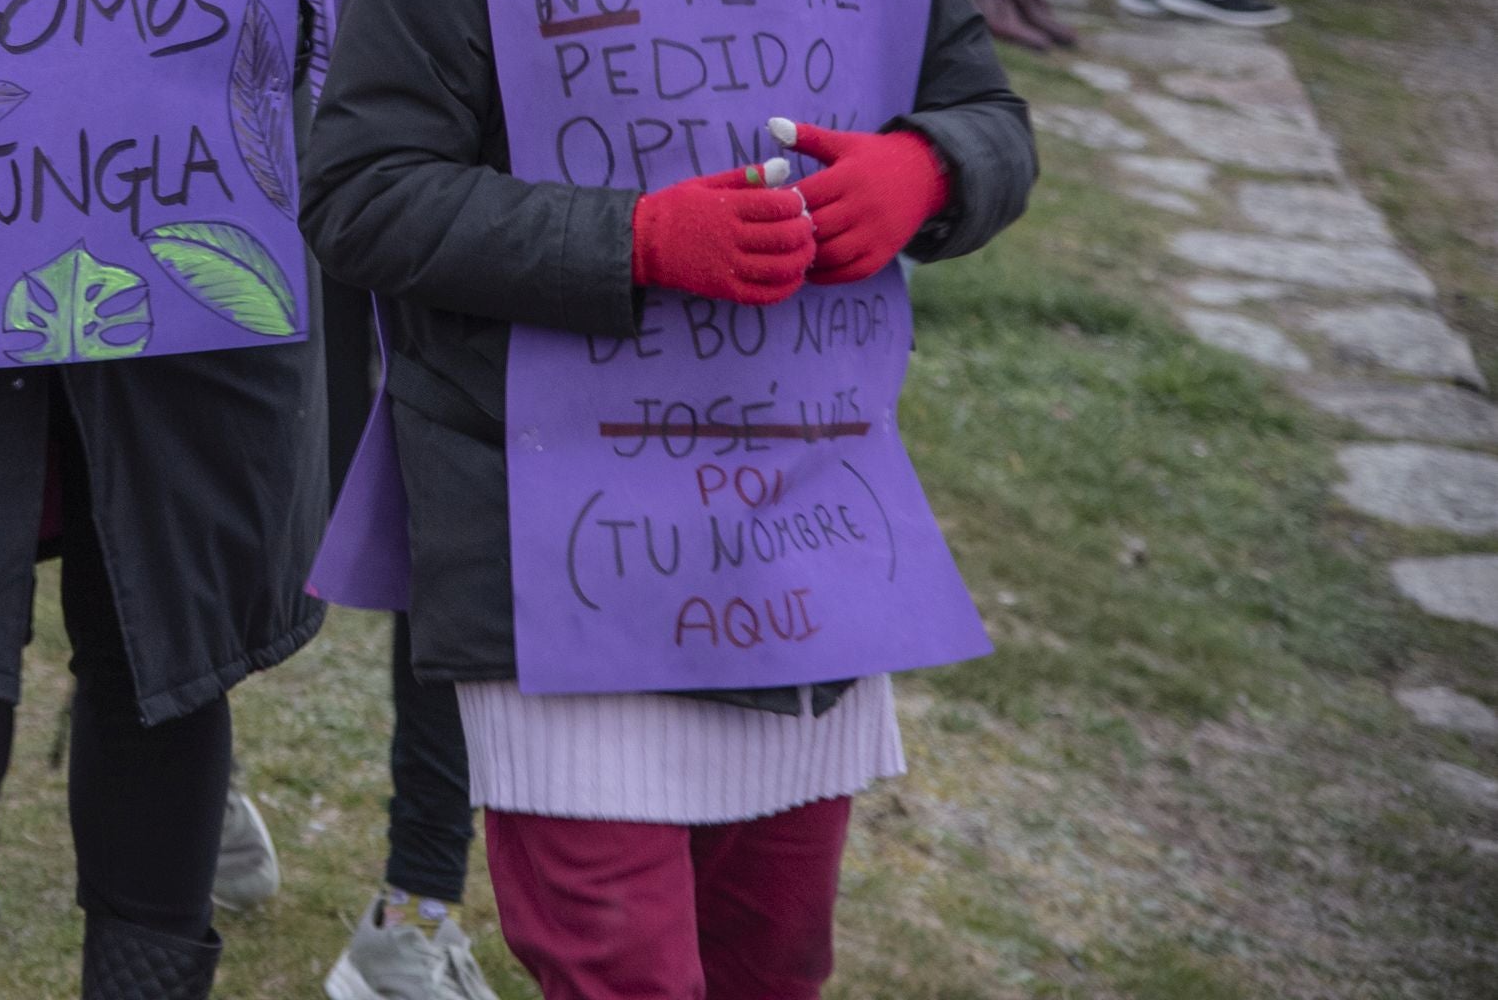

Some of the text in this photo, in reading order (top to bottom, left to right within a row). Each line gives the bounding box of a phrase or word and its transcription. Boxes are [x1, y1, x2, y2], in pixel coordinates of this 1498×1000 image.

[554, 32, 835, 100] PEDIDO
[612, 380, 778, 459] JOSÉ
[674, 587, 822, 650] AQUI
